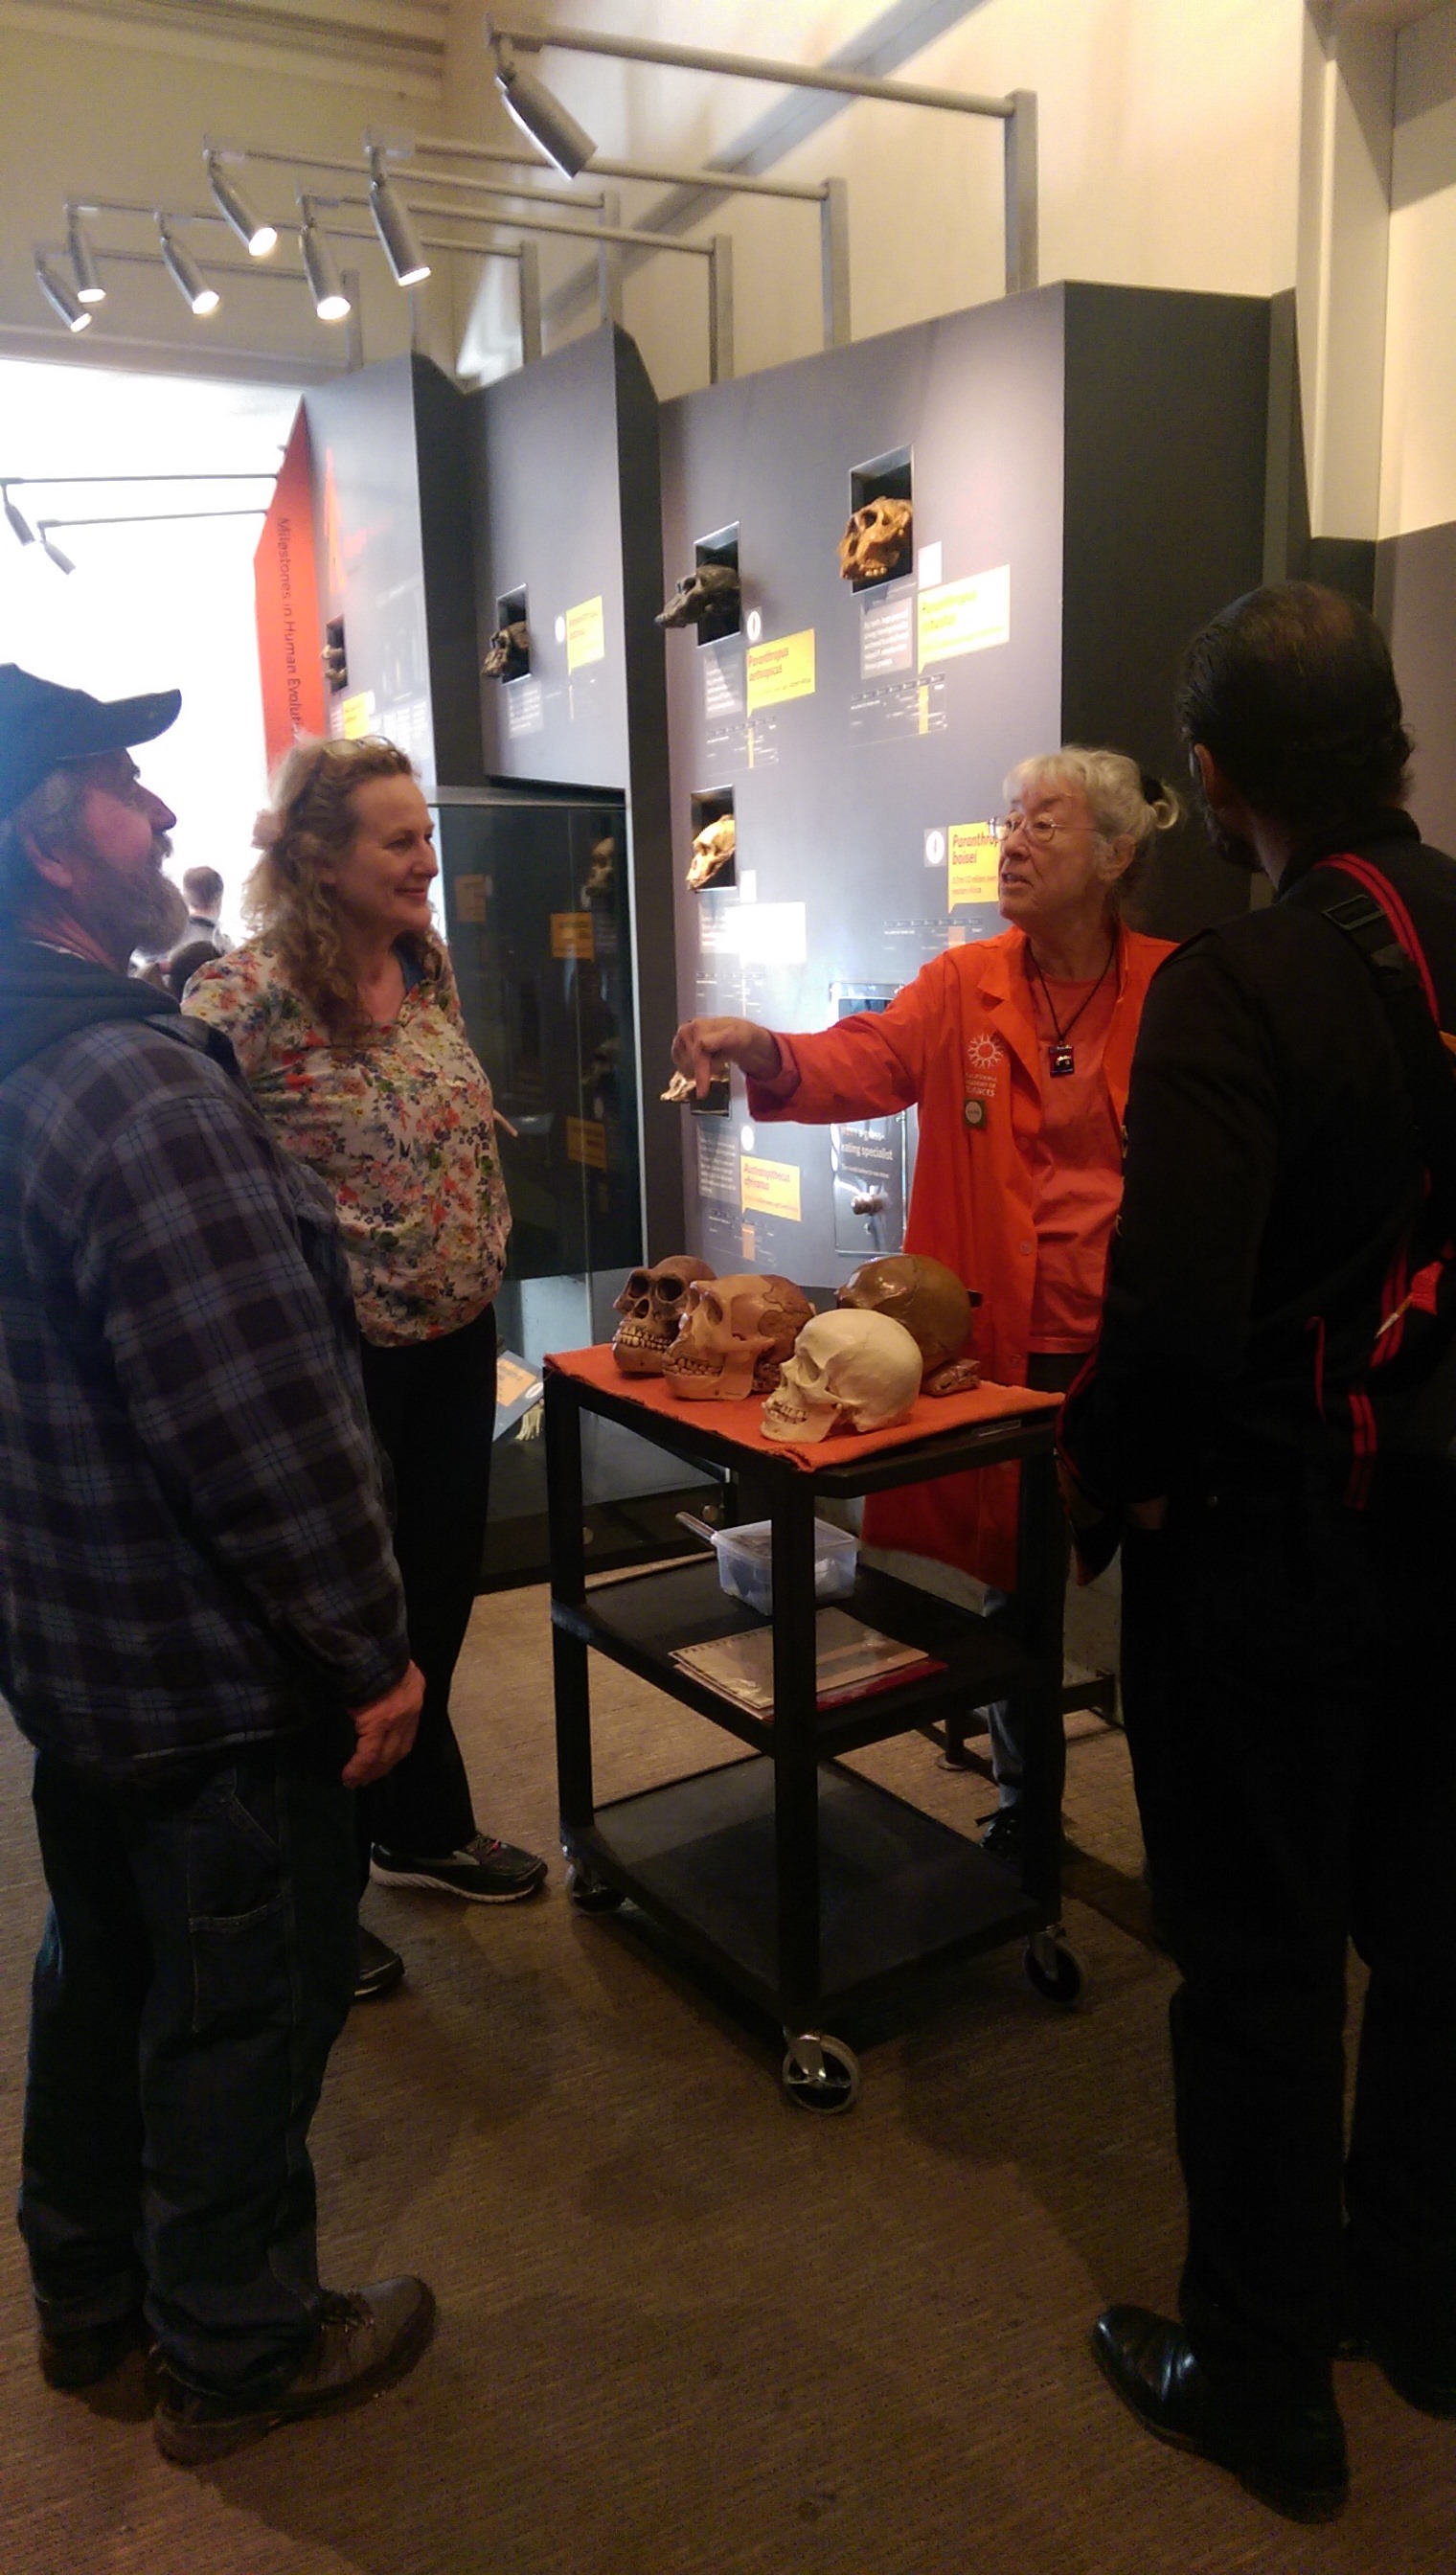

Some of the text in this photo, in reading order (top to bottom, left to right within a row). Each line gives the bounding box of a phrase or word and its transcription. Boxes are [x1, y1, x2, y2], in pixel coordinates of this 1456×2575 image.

[278, 517, 303, 725] Milestones in Human Evolut
[952, 831, 999, 849] Paranthrop
